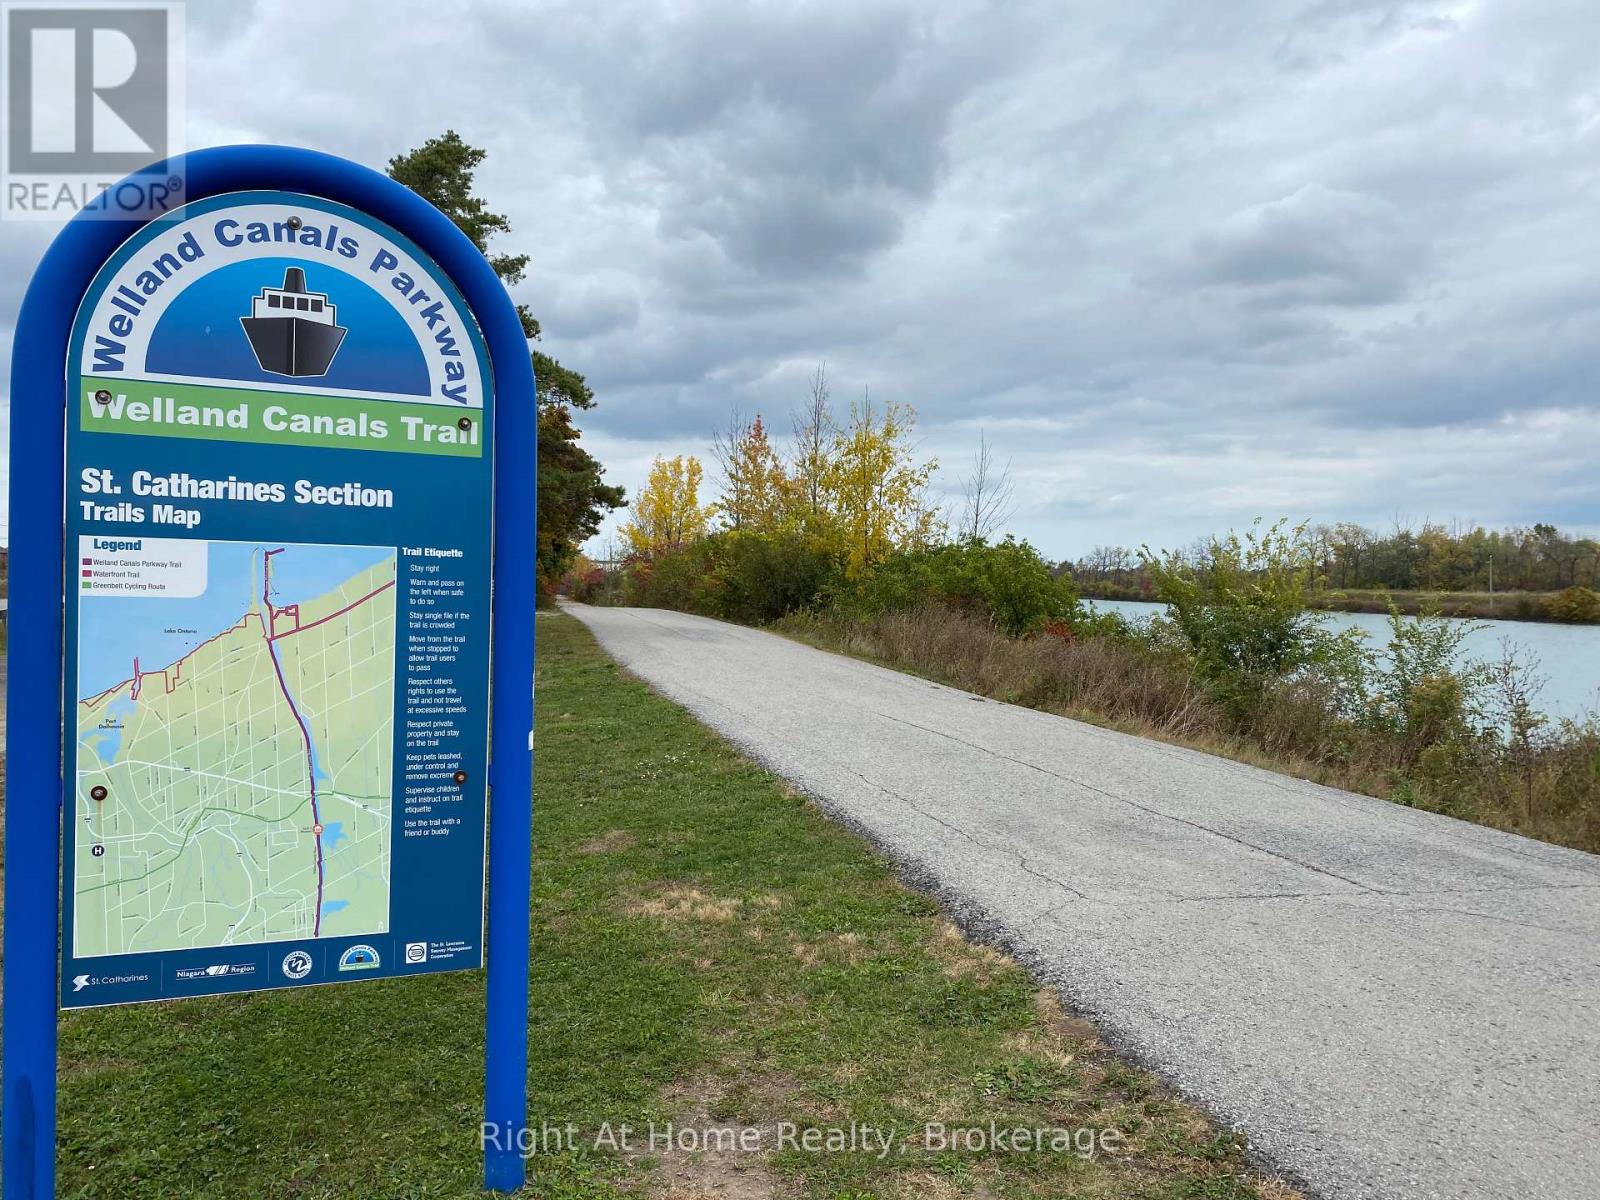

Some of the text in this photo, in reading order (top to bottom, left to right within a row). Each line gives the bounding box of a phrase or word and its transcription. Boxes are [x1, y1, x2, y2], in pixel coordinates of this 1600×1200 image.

[92, 219, 468, 405] Welland Canals Parkway
[87, 391, 478, 445] Welland Canals Trail
[80, 467, 393, 508] St. Catharines Section
[79, 500, 201, 529] Trails Map
[93, 538, 142, 552] Legend
[402, 547, 464, 558] Trail Etiquette
[93, 559, 118, 567] Welland
[141, 561, 168, 569] Parkway
[410, 564, 440, 573] Stay right
[93, 570, 126, 578] Waterfront
[124, 583, 147, 591] Cycling
[409, 611, 423, 620] Stay
[424, 612, 442, 620] single
[409, 621, 456, 629] trail is crowded
[409, 635, 466, 643] Move from the trail
[426, 645, 451, 653] stopped
[407, 677, 433, 686] Respect
[407, 688, 425, 696] rights
[445, 696, 462, 704] travel
[415, 706, 444, 714] excessive
[445, 705, 467, 714] speeds
[407, 720, 454, 728] Respect private
[433, 729, 446, 737] and
[446, 729, 460, 738] stay
[406, 752, 463, 762] Keep pets leashed,
[424, 762, 446, 770] control
[405, 785, 460, 795] Supervise children
[405, 796, 417, 804] and
[418, 795, 441, 803] instruct
[404, 806, 432, 814] etiquette
[404, 820, 416, 828] Use
[418, 819, 428, 827] the
[404, 829, 422, 837] friend
[431, 828, 450, 836] buddy
[176, 965, 255, 979] Niagara Region
[91, 974, 149, 986] St. Catharines
